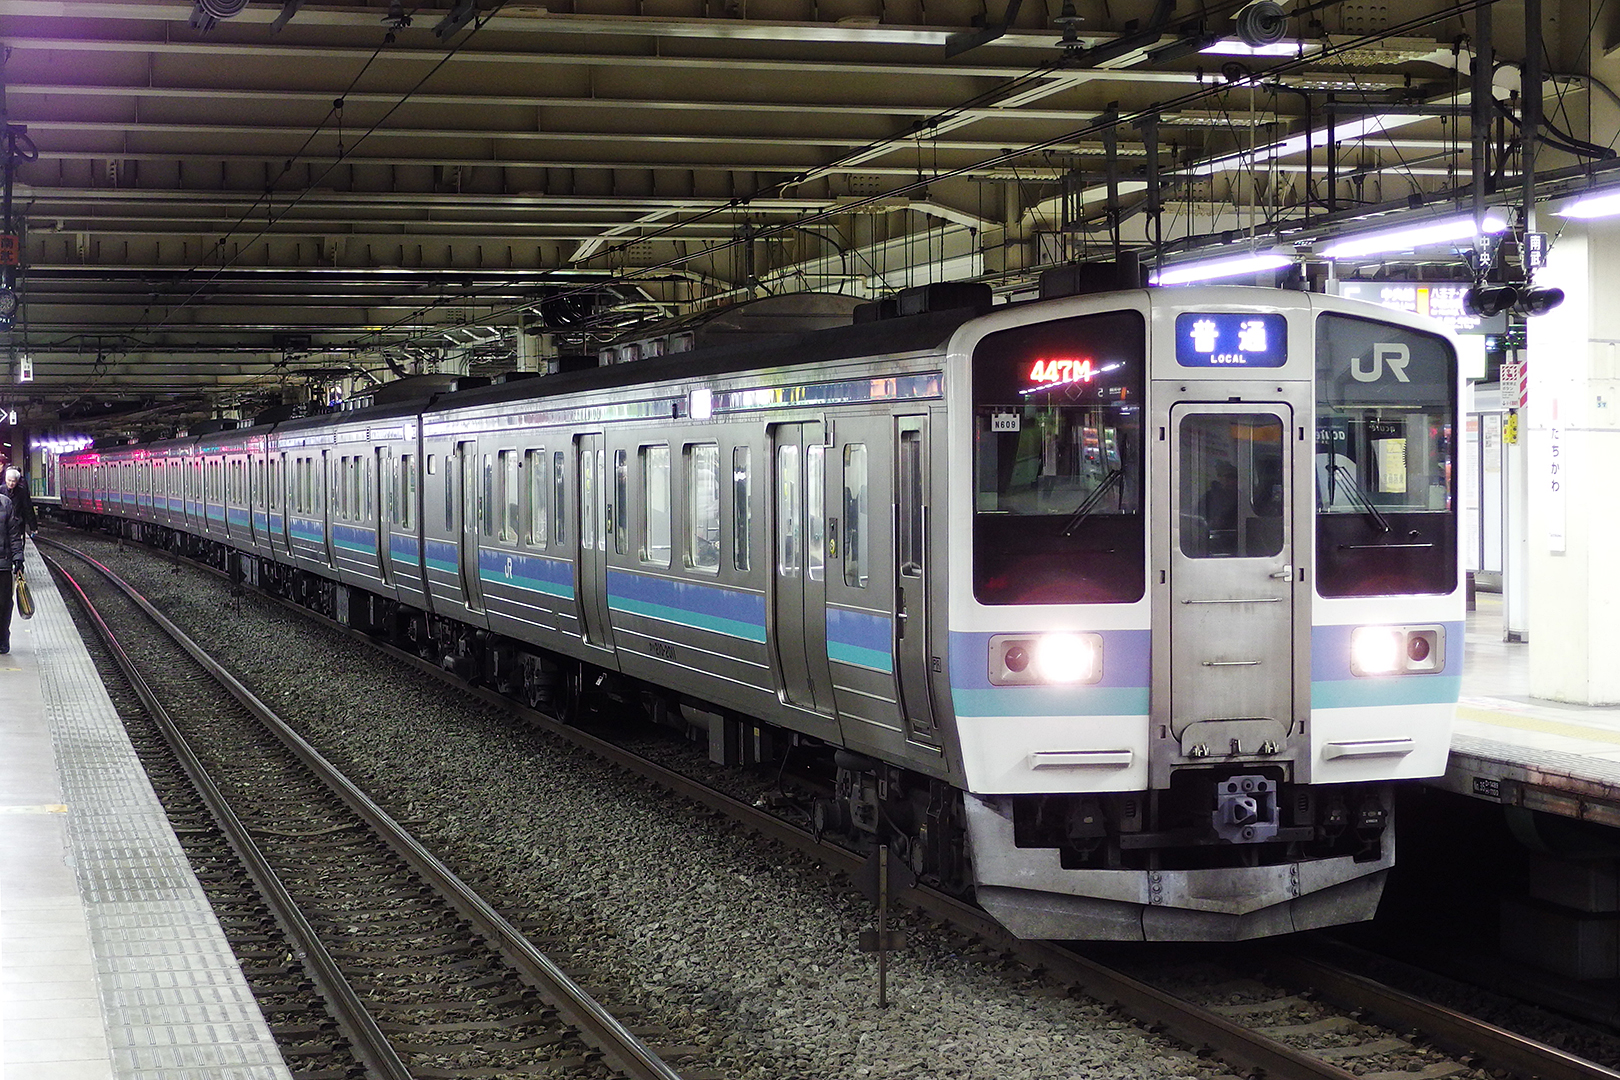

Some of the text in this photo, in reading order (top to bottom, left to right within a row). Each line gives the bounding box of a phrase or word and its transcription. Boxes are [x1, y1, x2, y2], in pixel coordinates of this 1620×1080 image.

[1479, 236, 1491, 267] 中央
[1210, 354, 1246, 364] LOCAL
[1351, 343, 1410, 383] JR
[1029, 360, 1091, 383] 447M
[994, 420, 1016, 429] N609
[1550, 428, 1560, 492] たちかわ
[504, 557, 513, 579] JR
